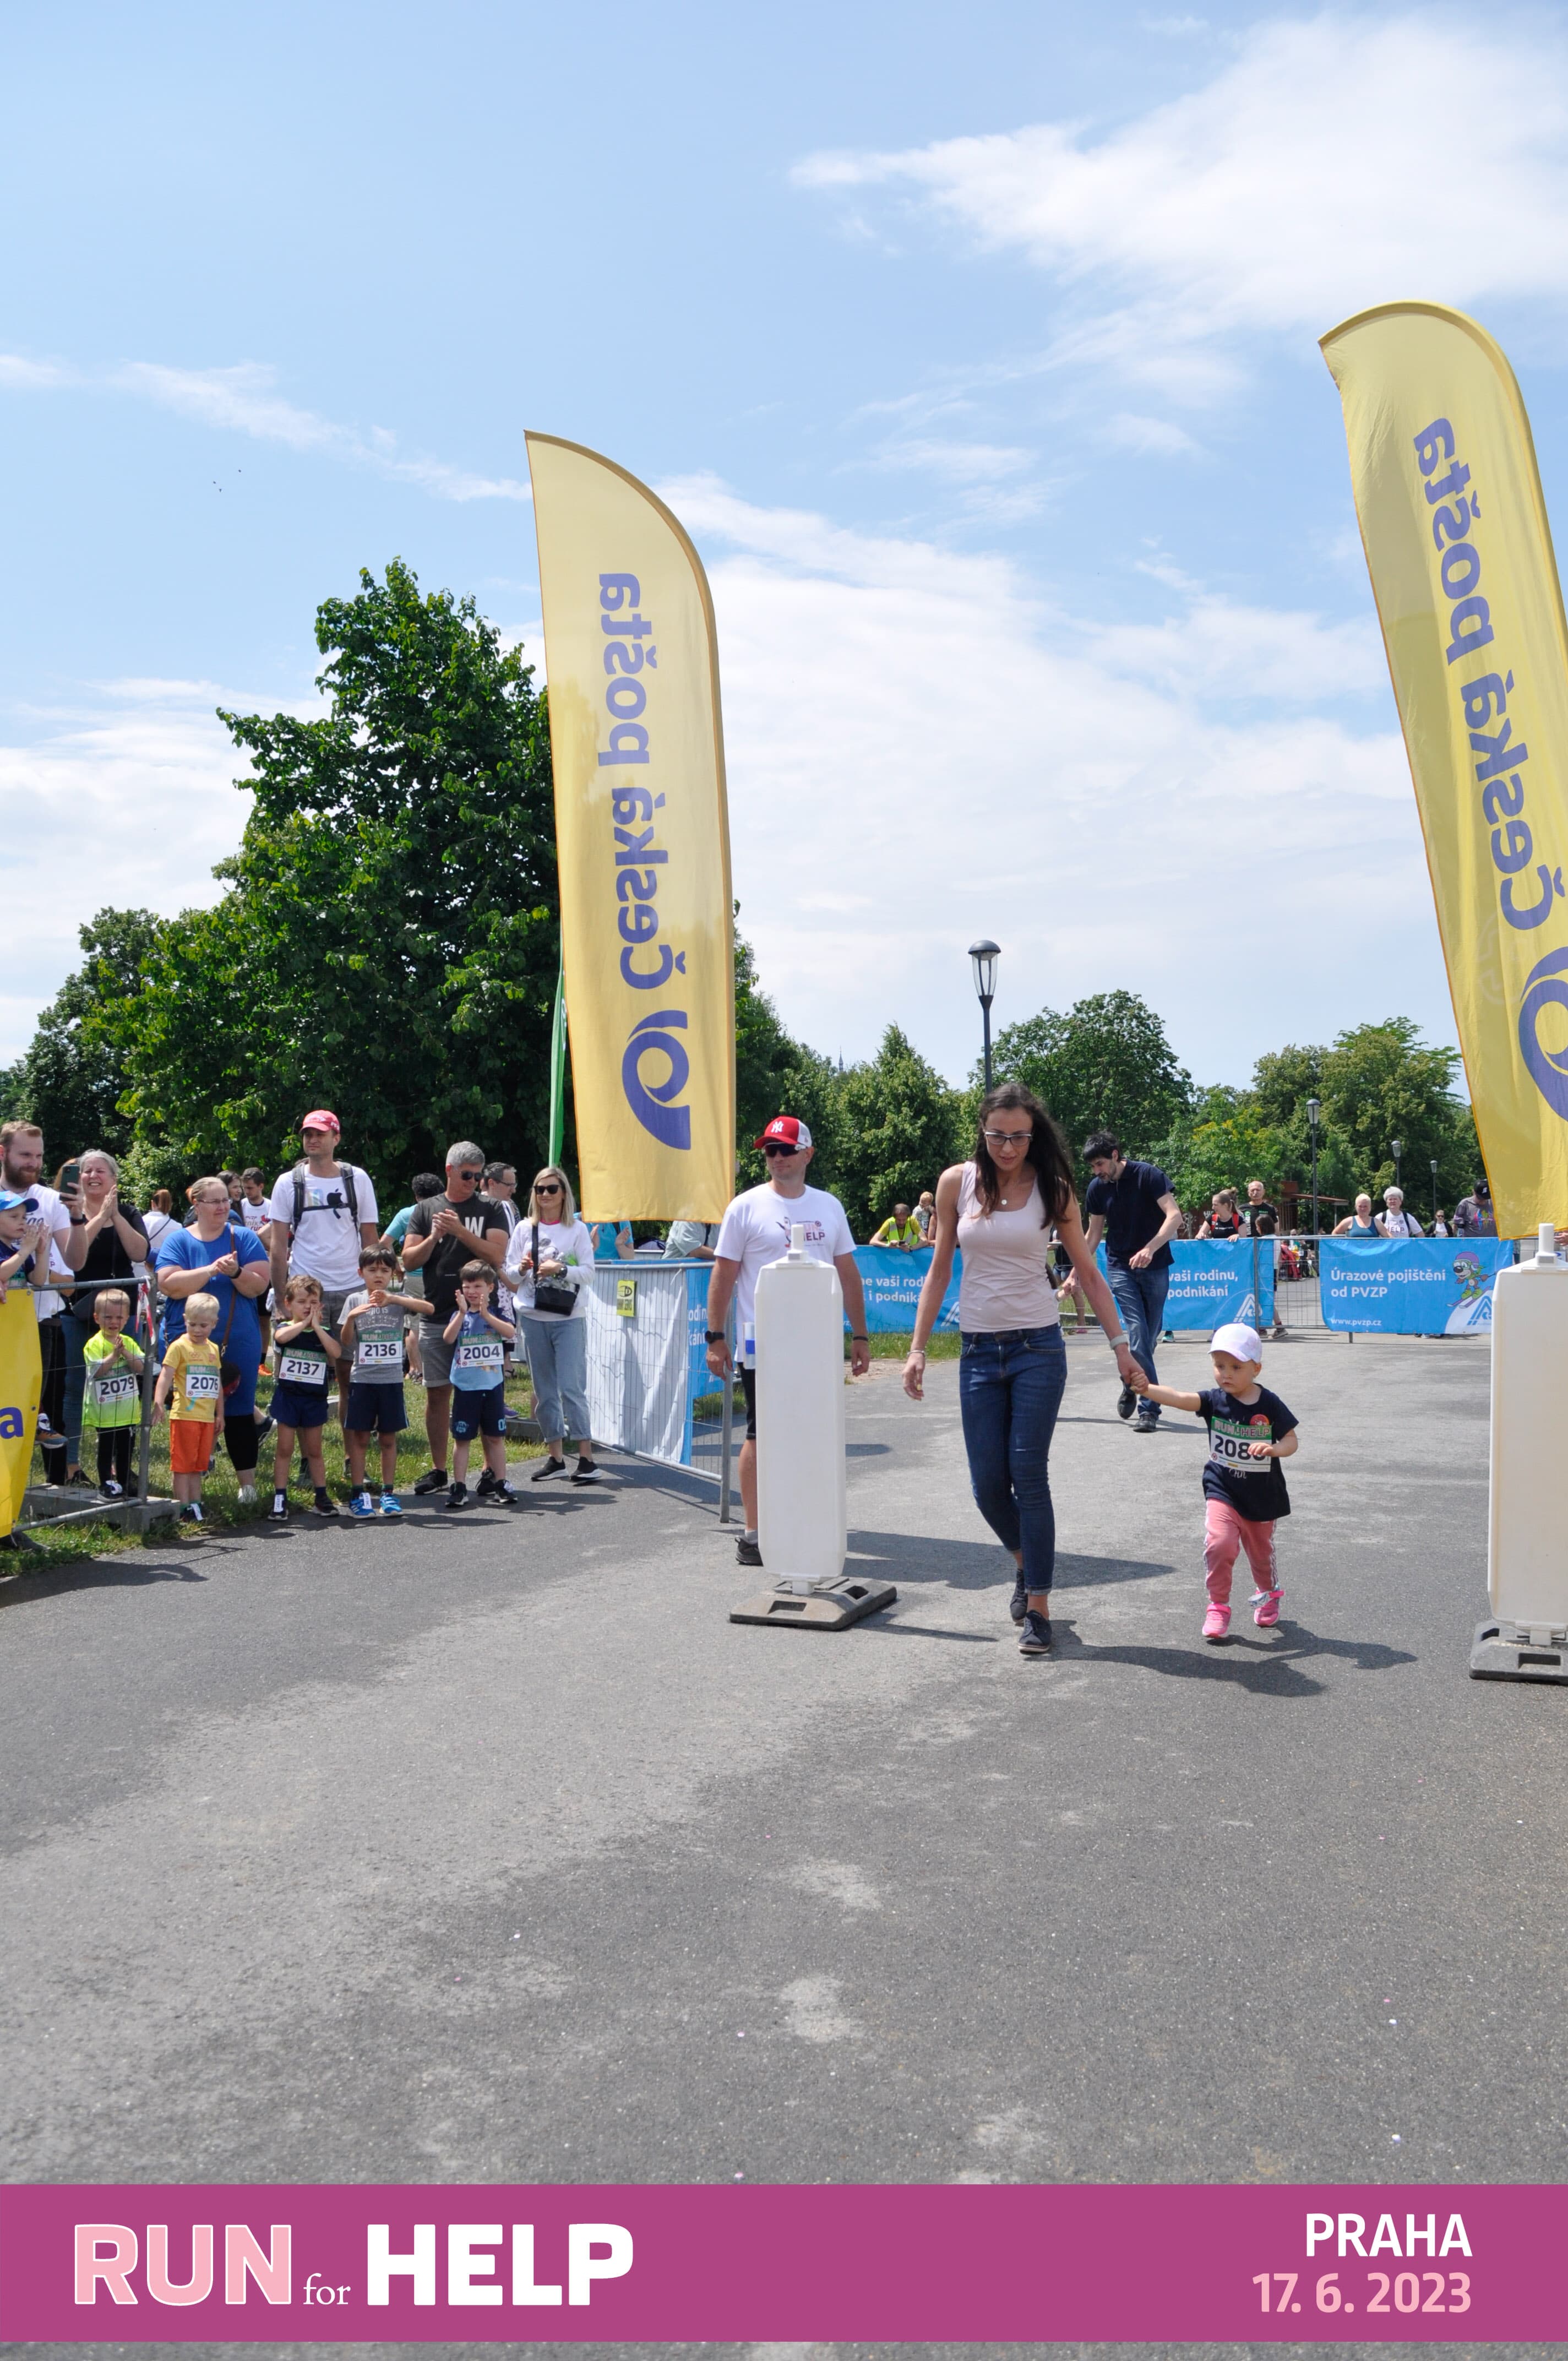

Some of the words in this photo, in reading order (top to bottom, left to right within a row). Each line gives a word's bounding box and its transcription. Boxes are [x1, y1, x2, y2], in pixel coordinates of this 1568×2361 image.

[803, 1232, 825, 1241] ELP
[876, 1275, 900, 1287] vaši
[1169, 1270, 1191, 1282] vaši
[1194, 1269, 1238, 1282] rodinu,
[1330, 1267, 1384, 1281] Úrazové
[1387, 1269, 1446, 1283] pojištění
[1167, 1285, 1228, 1299] podnikání
[1331, 1286, 1348, 1297] od
[1352, 1287, 1388, 1298] PVZP
[1330, 1319, 1382, 1327] www.pvzp.cz
[364, 1343, 397, 1357] 2136
[464, 1345, 500, 1360] 2004
[287, 1359, 320, 1375] 2137
[100, 1375, 134, 1395] 2079
[190, 1377, 218, 1390] 2076
[1214, 1420, 1235, 1435] RUN
[1241, 1427, 1270, 1438] HELP
